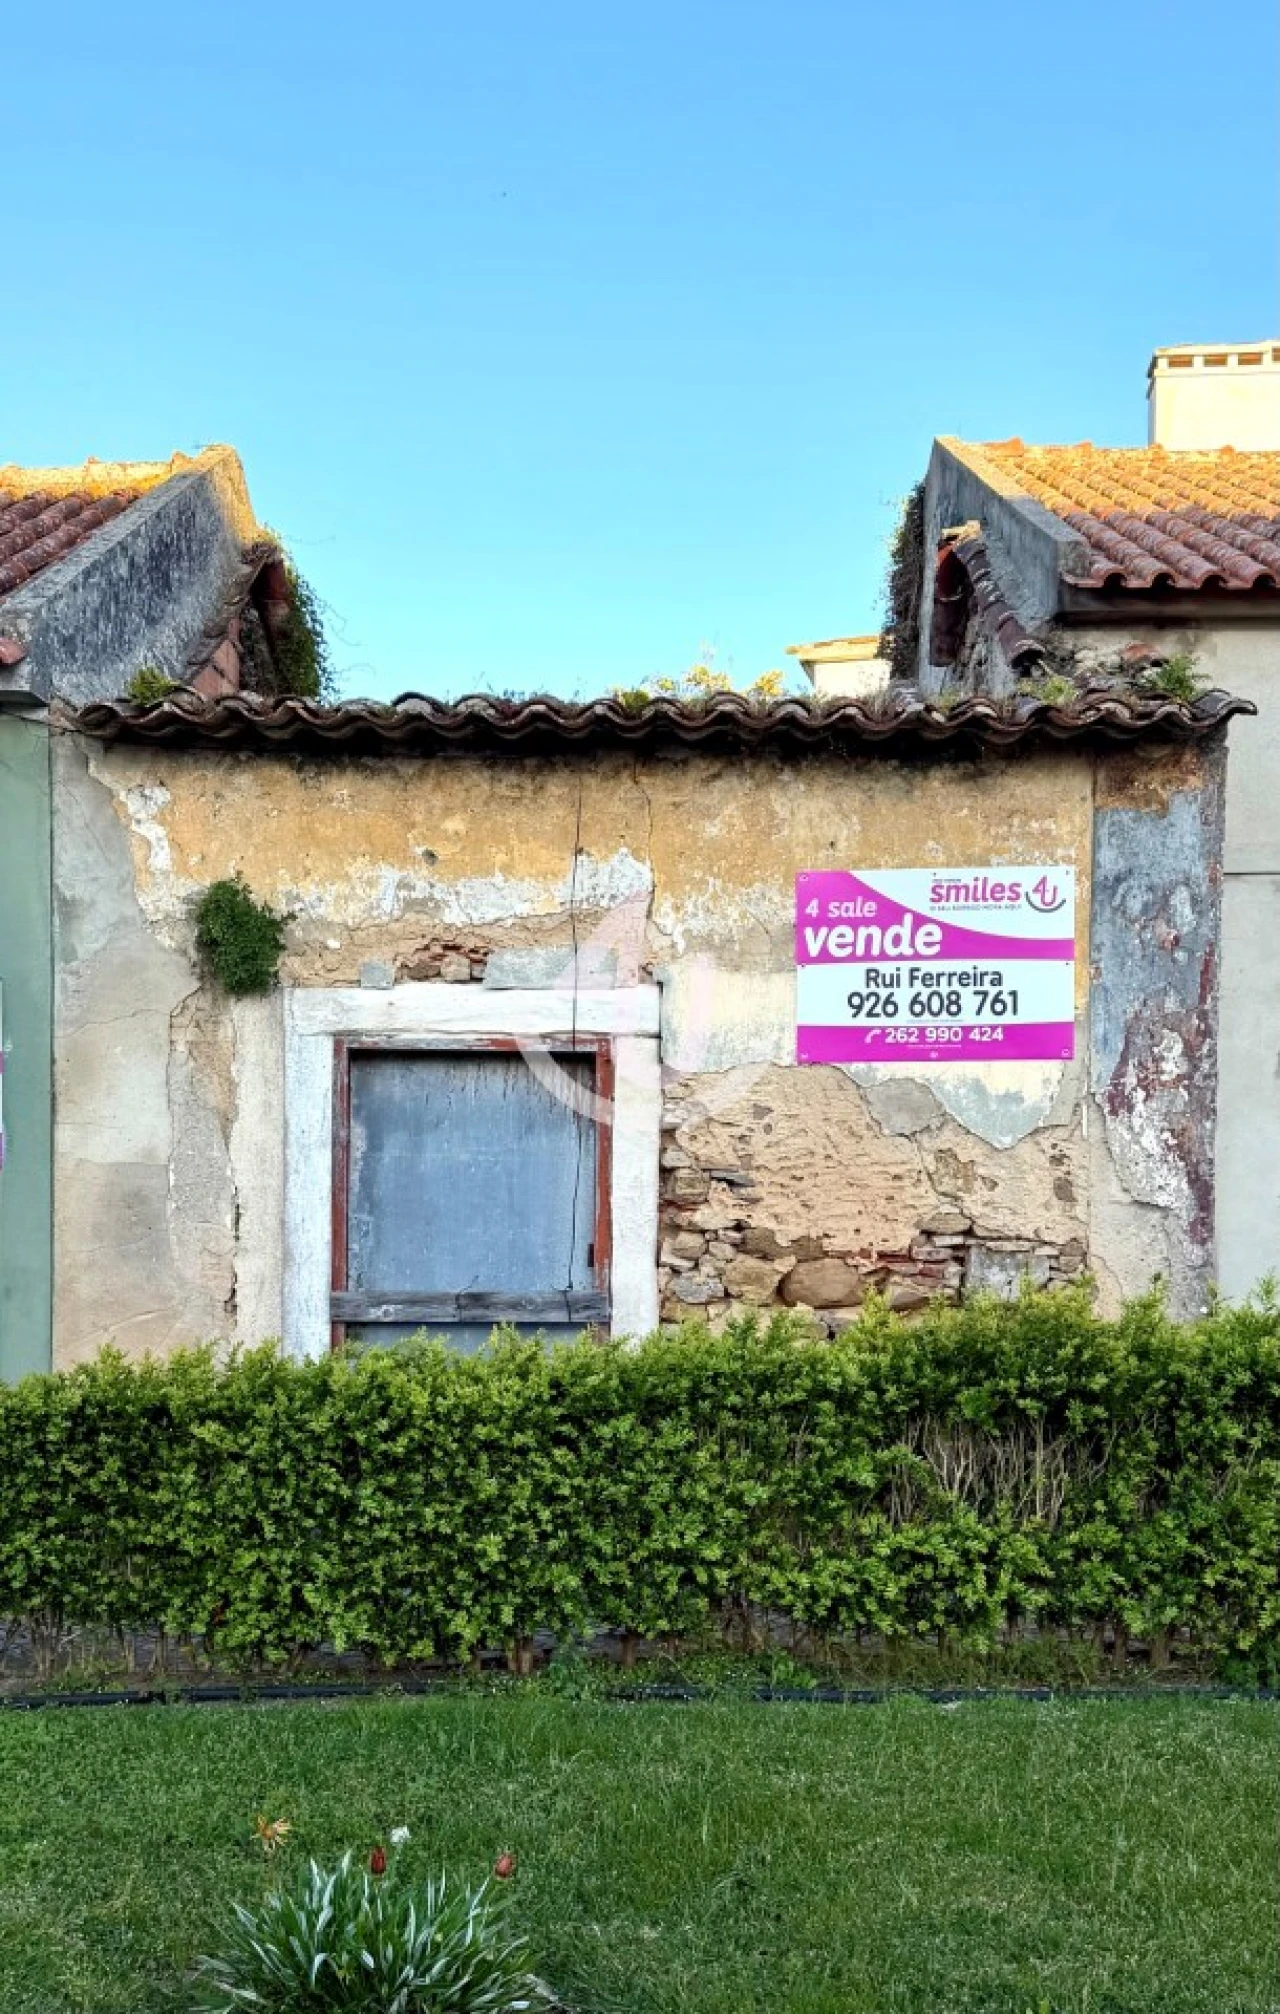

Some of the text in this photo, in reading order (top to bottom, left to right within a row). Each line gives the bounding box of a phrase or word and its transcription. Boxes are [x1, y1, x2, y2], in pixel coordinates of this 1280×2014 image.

[929, 876, 1022, 902] smiles
[804, 896, 877, 917] 4 sale
[804, 913, 942, 957] vende
[865, 966, 1004, 989] Rui Ferreira
[847, 990, 1018, 1018] 926 608 761
[884, 1026, 1004, 1043] 262 990 424
